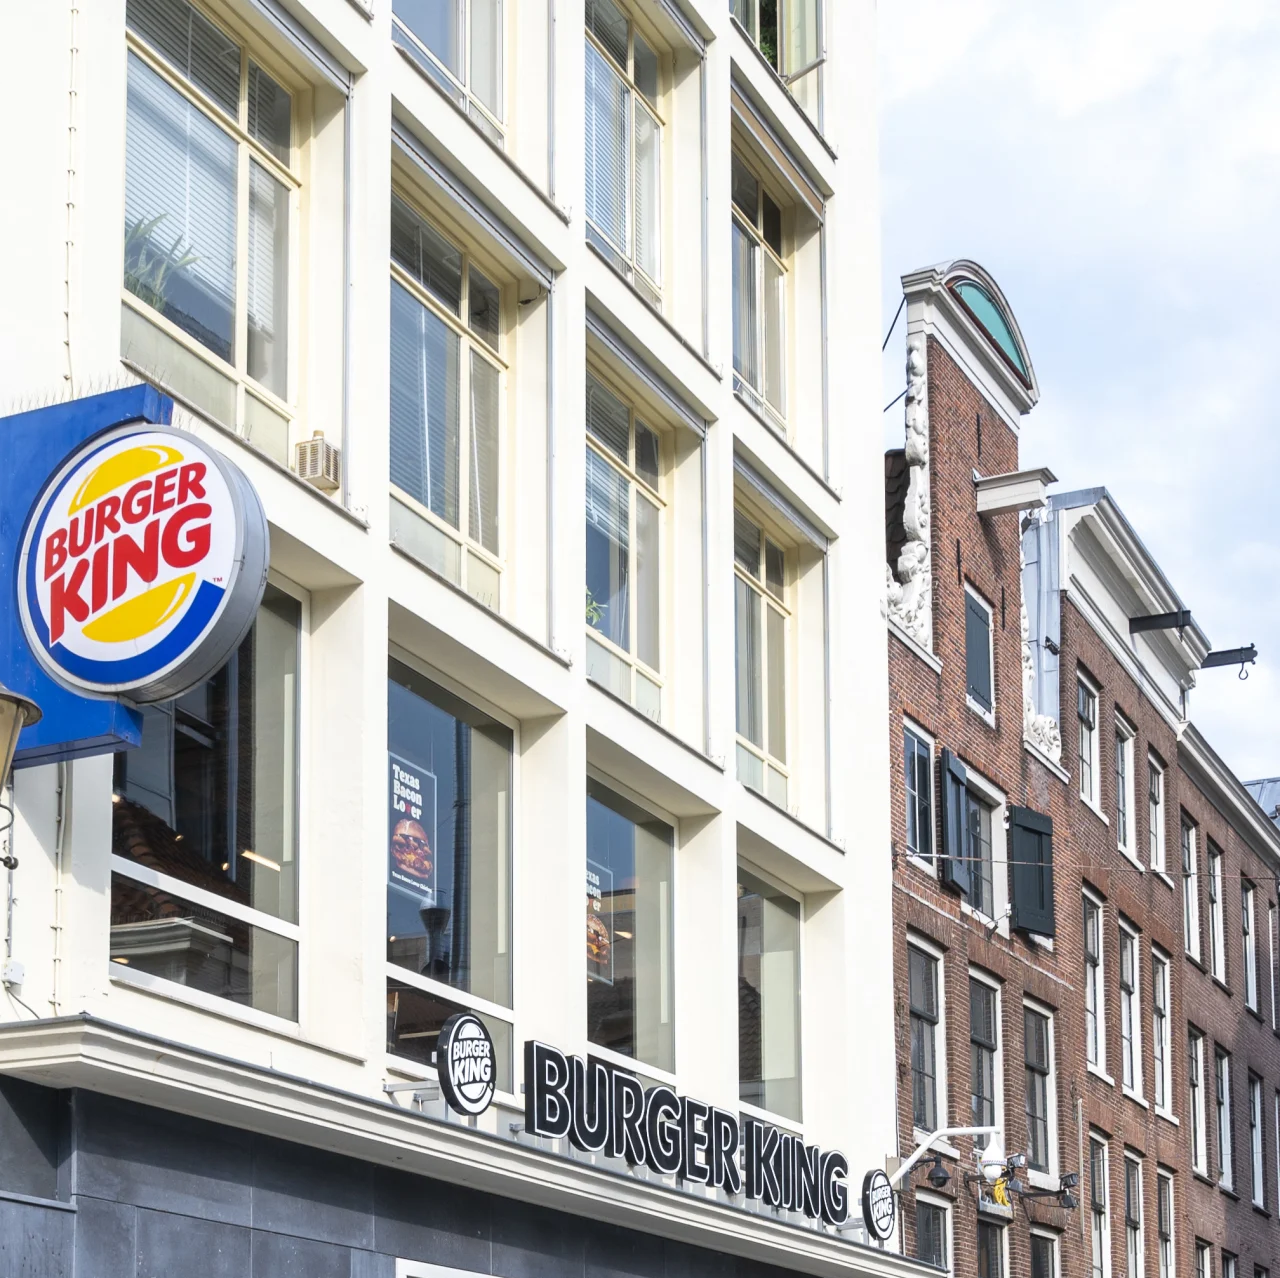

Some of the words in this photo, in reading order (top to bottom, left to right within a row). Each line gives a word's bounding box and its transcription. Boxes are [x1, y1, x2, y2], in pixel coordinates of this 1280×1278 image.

[44, 462, 207, 582] BURGER
[51, 503, 212, 644] KING
[392, 764, 421, 790] Texas
[393, 779, 422, 807] Bacon
[453, 1040, 491, 1061] BURGER
[453, 1057, 492, 1086] KING
[524, 1040, 742, 1195] BURGER
[745, 1121, 850, 1227] KING
[873, 1197, 893, 1223] KING
